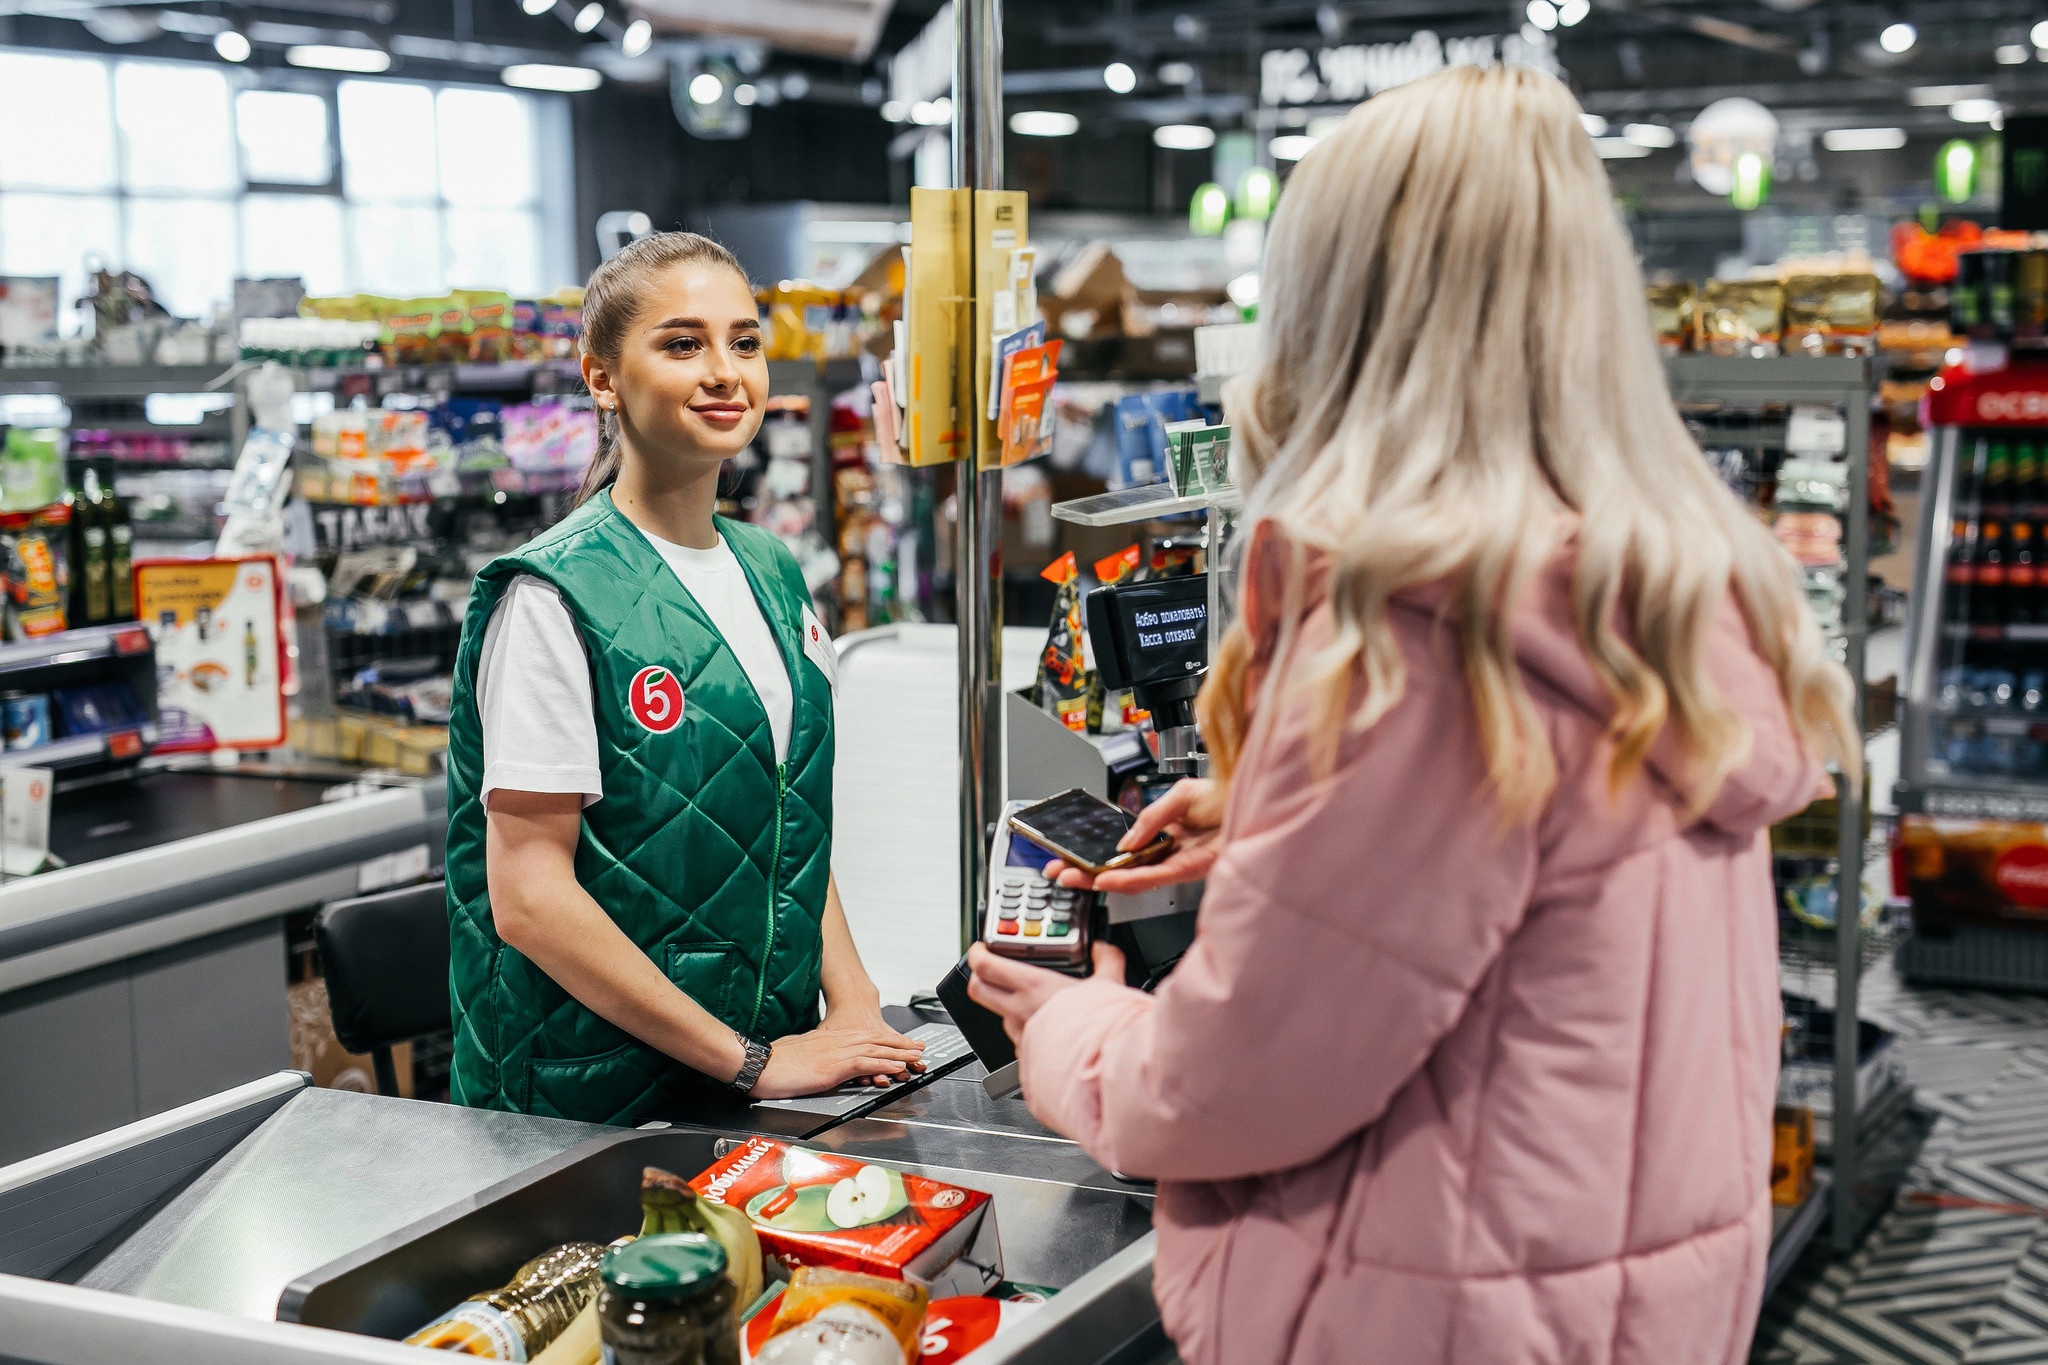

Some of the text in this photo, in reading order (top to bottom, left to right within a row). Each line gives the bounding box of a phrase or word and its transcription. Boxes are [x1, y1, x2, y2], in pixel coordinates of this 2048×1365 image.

[1135, 604, 1206, 628] Добро пожаловать!
[1138, 628, 1196, 648] Касса открыта
[643, 668, 671, 721] 5
